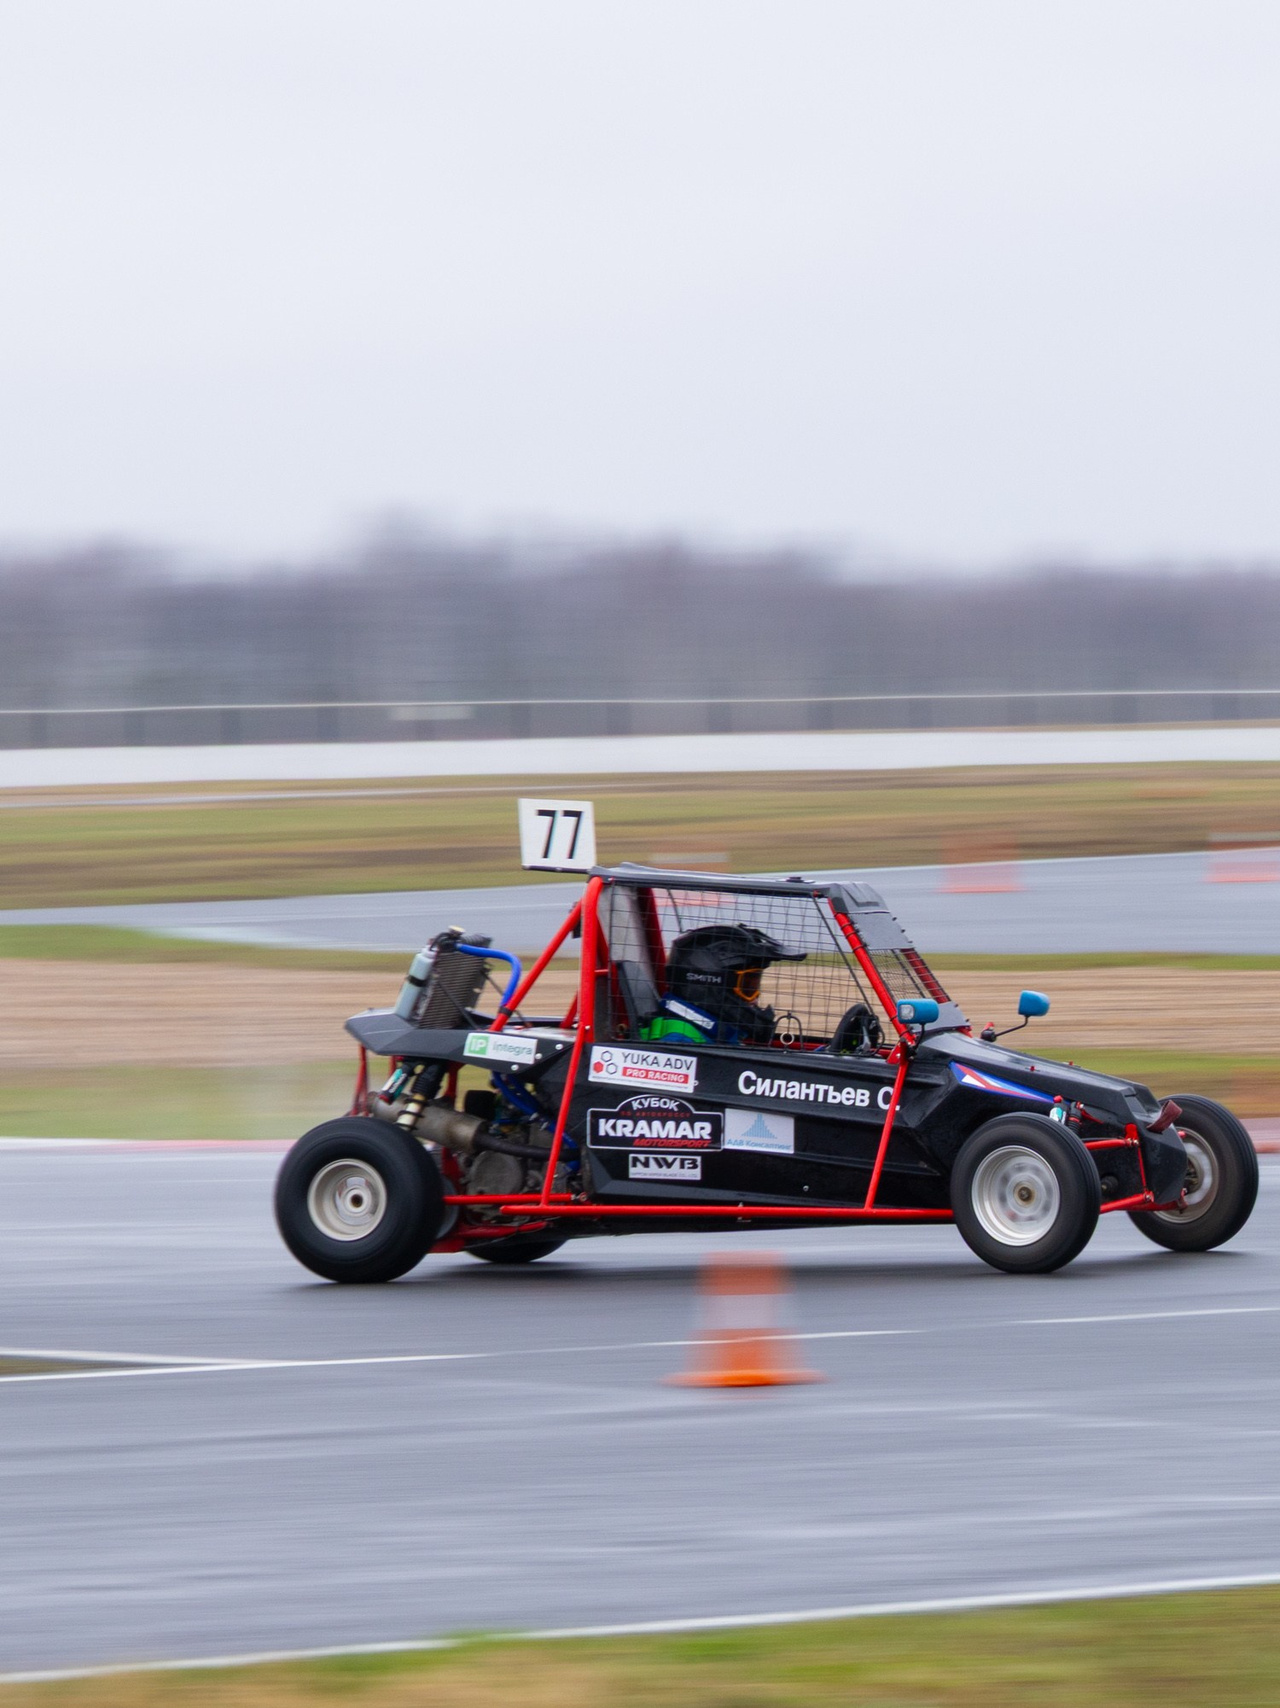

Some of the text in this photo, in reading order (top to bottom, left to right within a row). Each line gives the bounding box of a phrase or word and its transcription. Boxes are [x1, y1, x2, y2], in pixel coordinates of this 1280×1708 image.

[535, 809, 584, 859] 77
[686, 972, 722, 983] SMITH
[622, 1052, 693, 1071] YUKA ADV
[626, 1068, 646, 1078] PRO
[647, 1070, 685, 1083] RACING
[738, 1071, 870, 1107] Силантьев
[632, 1097, 680, 1112] КУБОК
[598, 1118, 712, 1140] KRAMAR
[633, 1138, 711, 1148] MOTORSPORT
[631, 1156, 699, 1170] NWB
